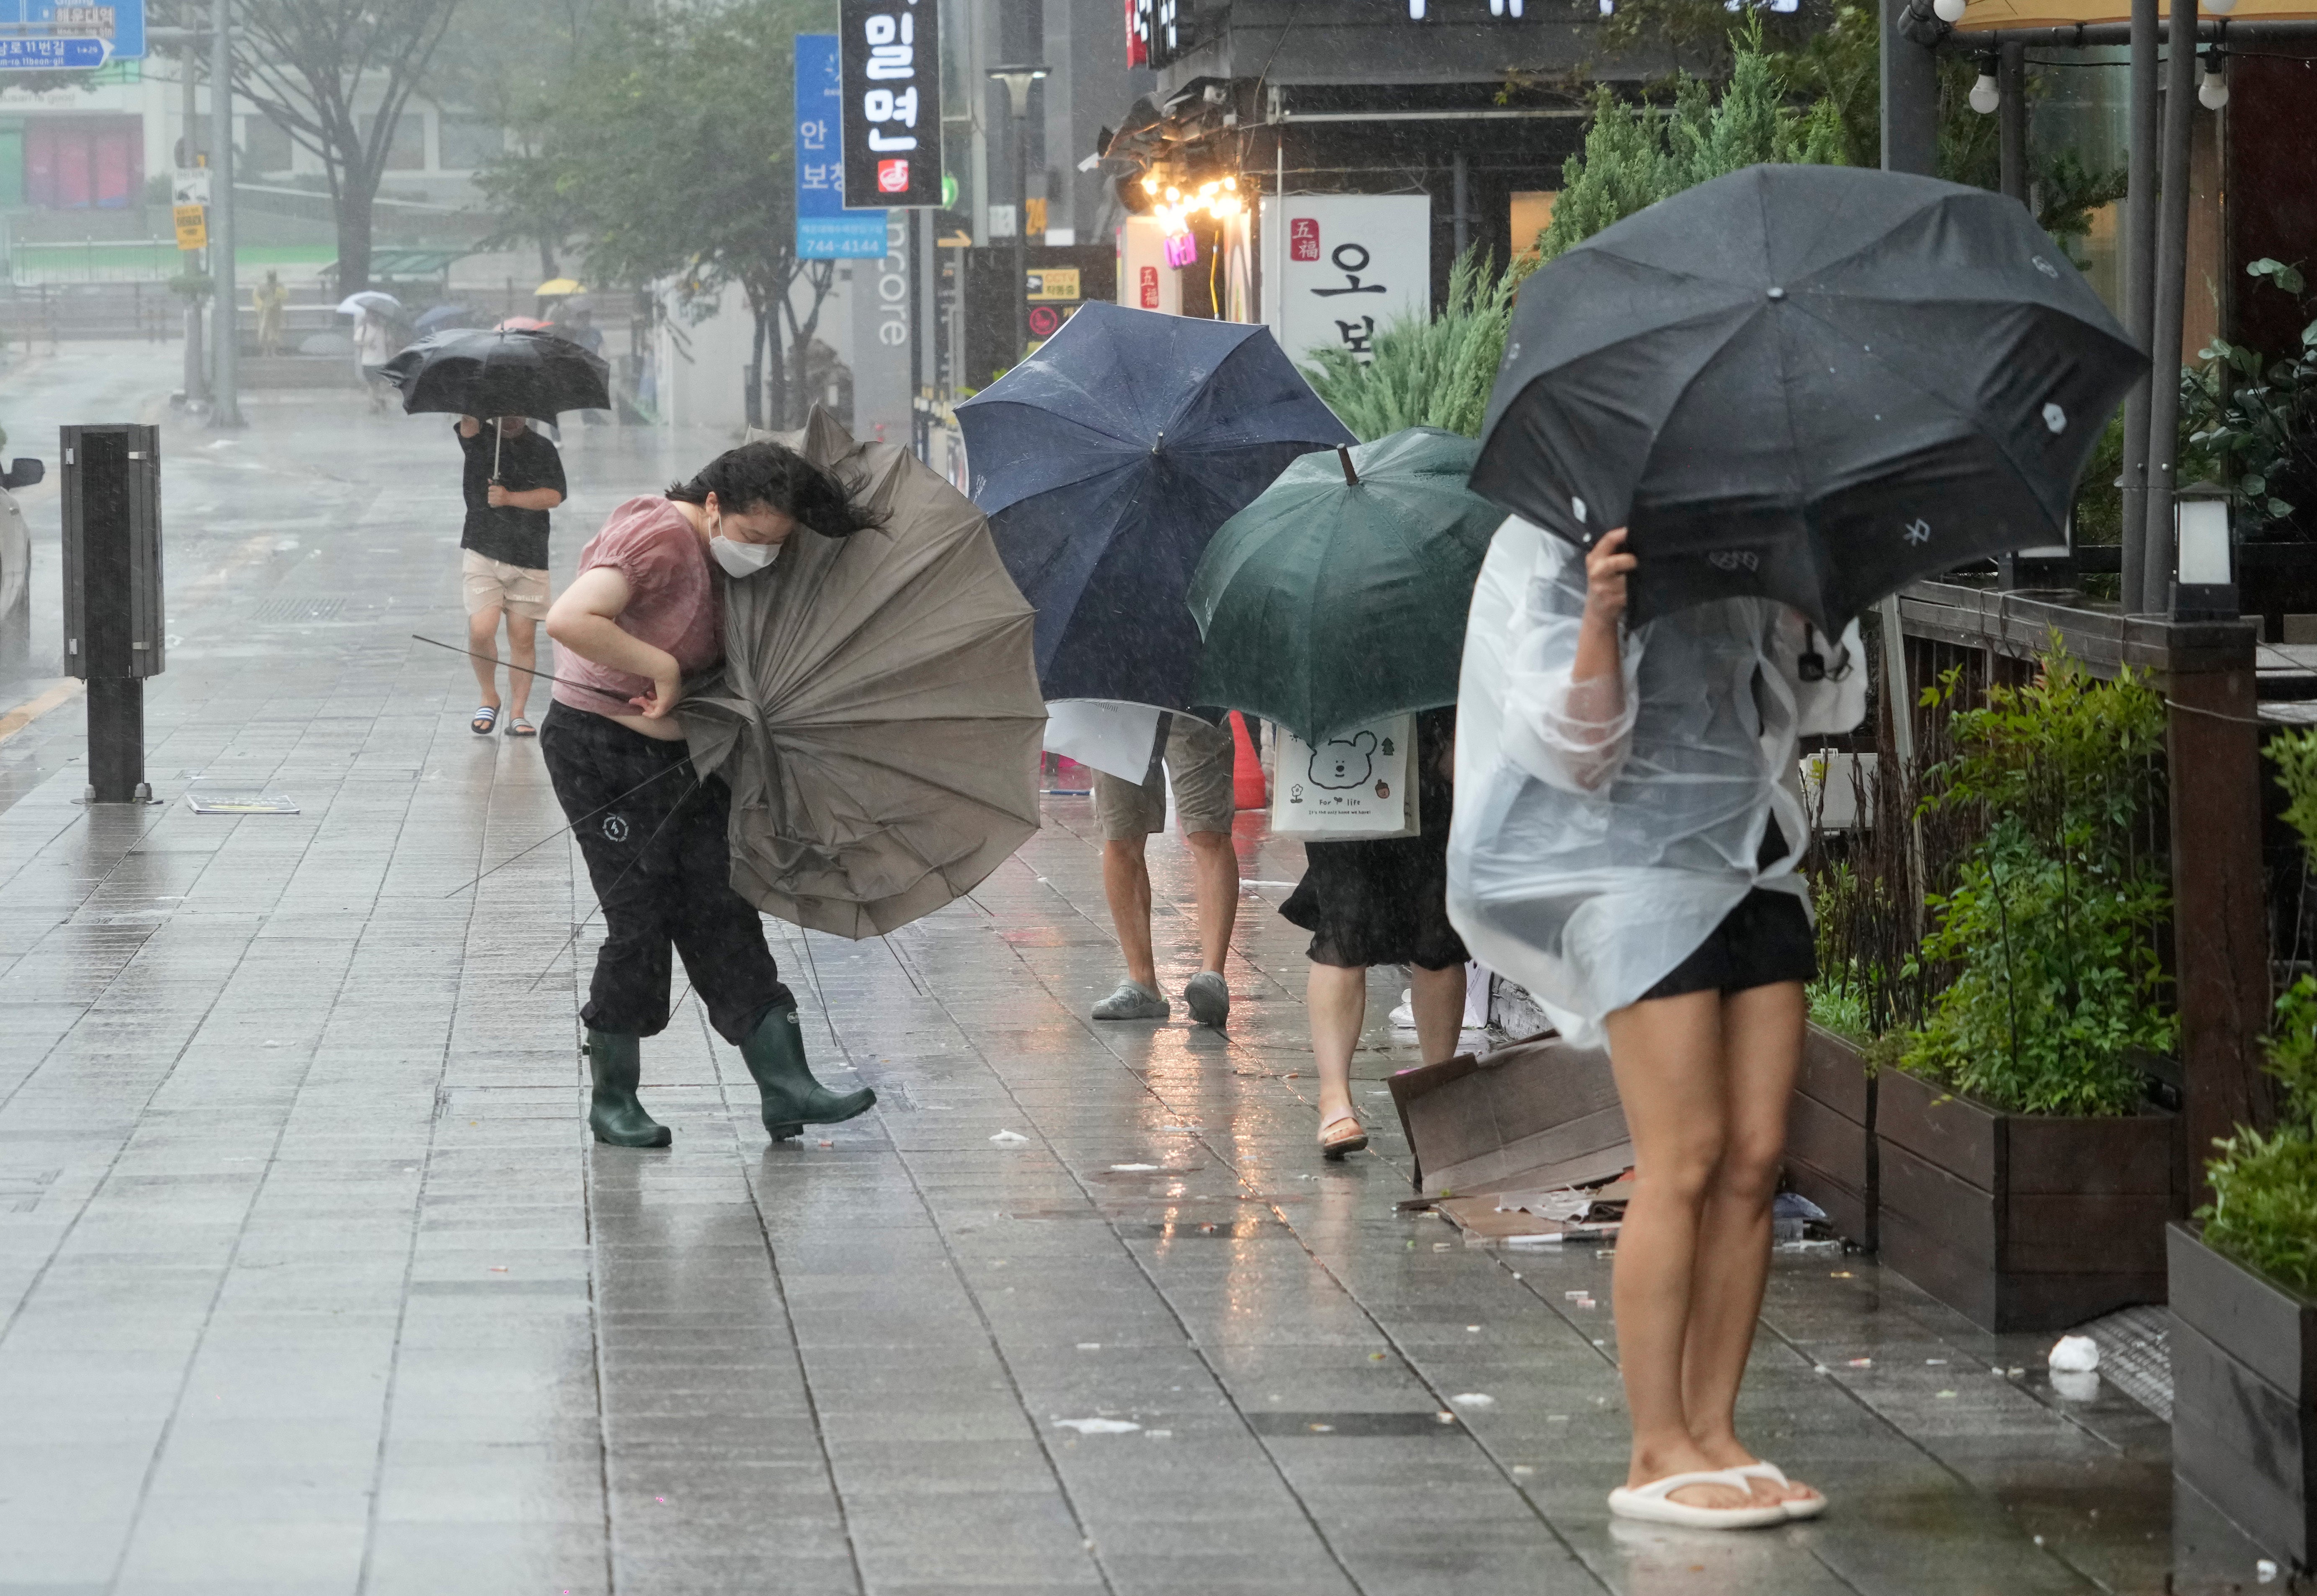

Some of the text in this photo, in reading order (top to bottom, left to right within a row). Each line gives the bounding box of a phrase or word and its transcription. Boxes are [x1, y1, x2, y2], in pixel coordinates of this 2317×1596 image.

[865, 0, 918, 152] 밀면
[807, 239, 879, 252] 744-4144
[879, 207, 906, 345] ncore
[1045, 273, 1076, 283] CCTV
